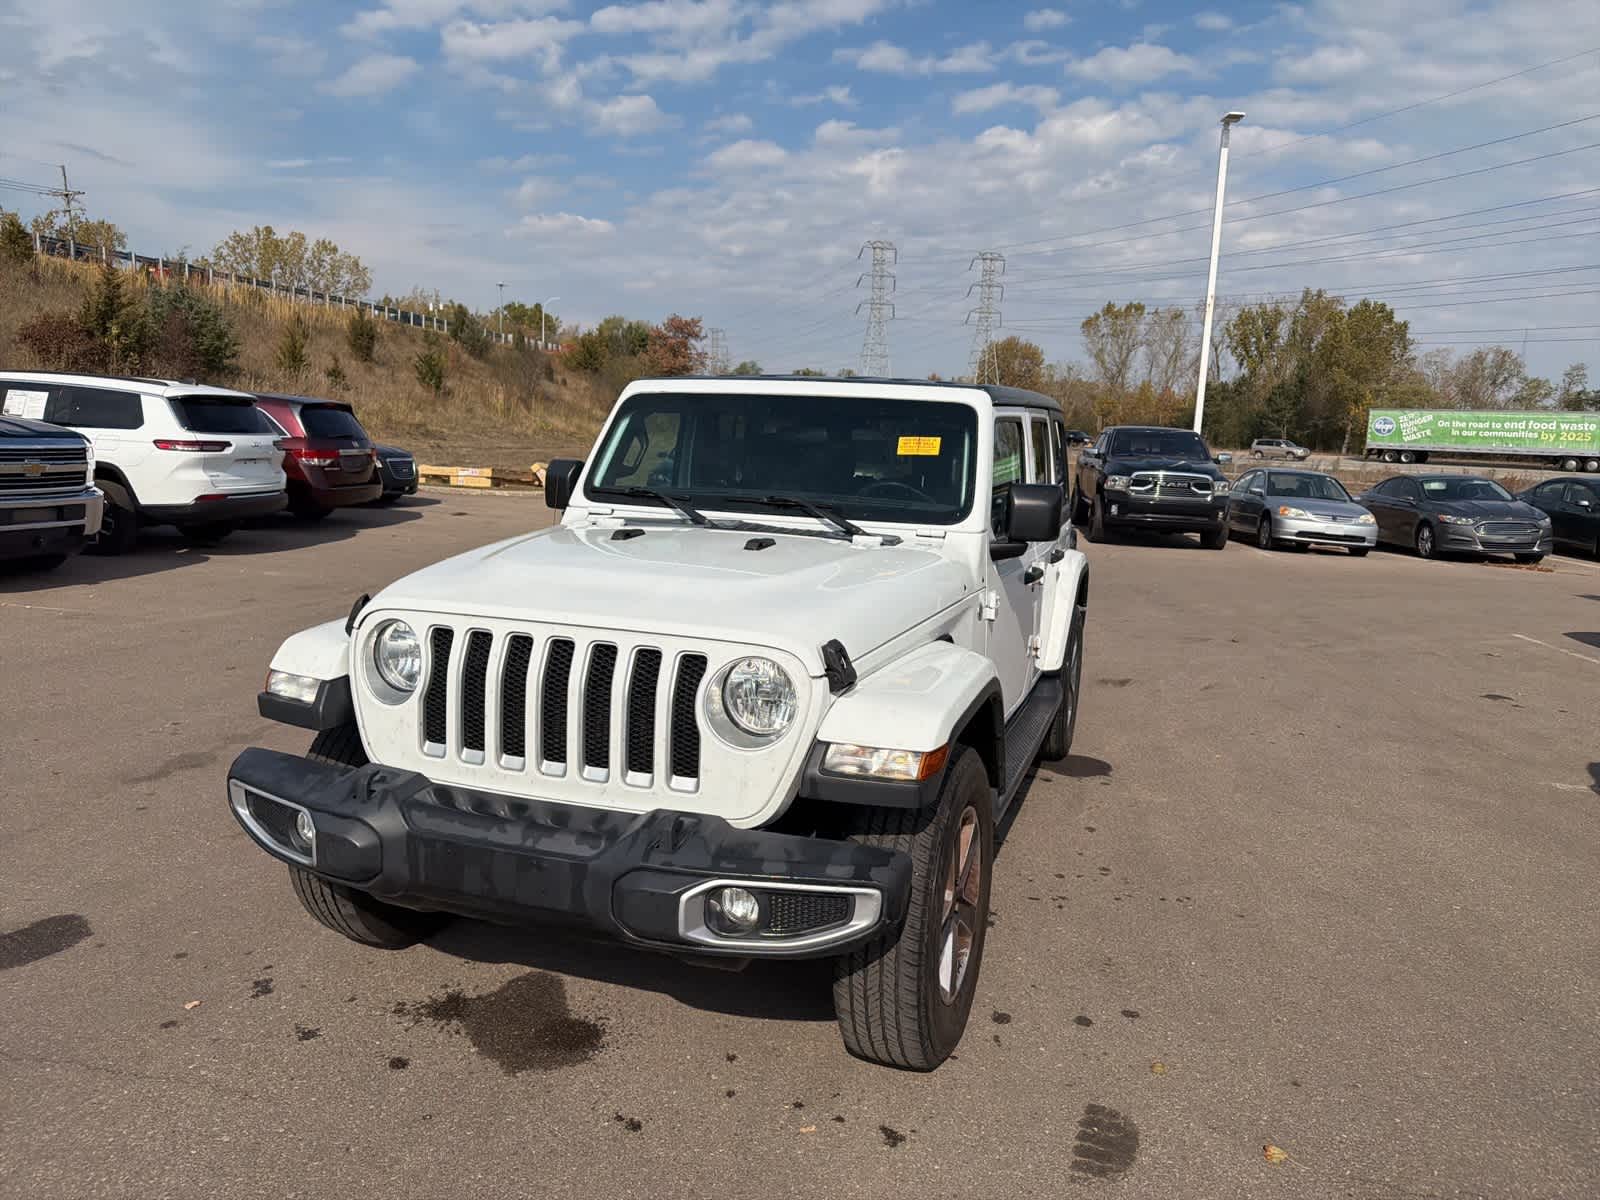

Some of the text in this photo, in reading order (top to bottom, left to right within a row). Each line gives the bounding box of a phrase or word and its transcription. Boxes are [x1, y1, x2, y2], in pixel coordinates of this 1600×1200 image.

[1452, 420, 1467, 428] the
[1504, 420, 1526, 429] end
[1528, 420, 1557, 430] food
[1559, 422, 1597, 431] waste
[1402, 429, 1432, 442] WASTE
[1478, 430, 1538, 438] communities
[1540, 430, 1557, 442] by
[1559, 431, 1592, 441] 2025
